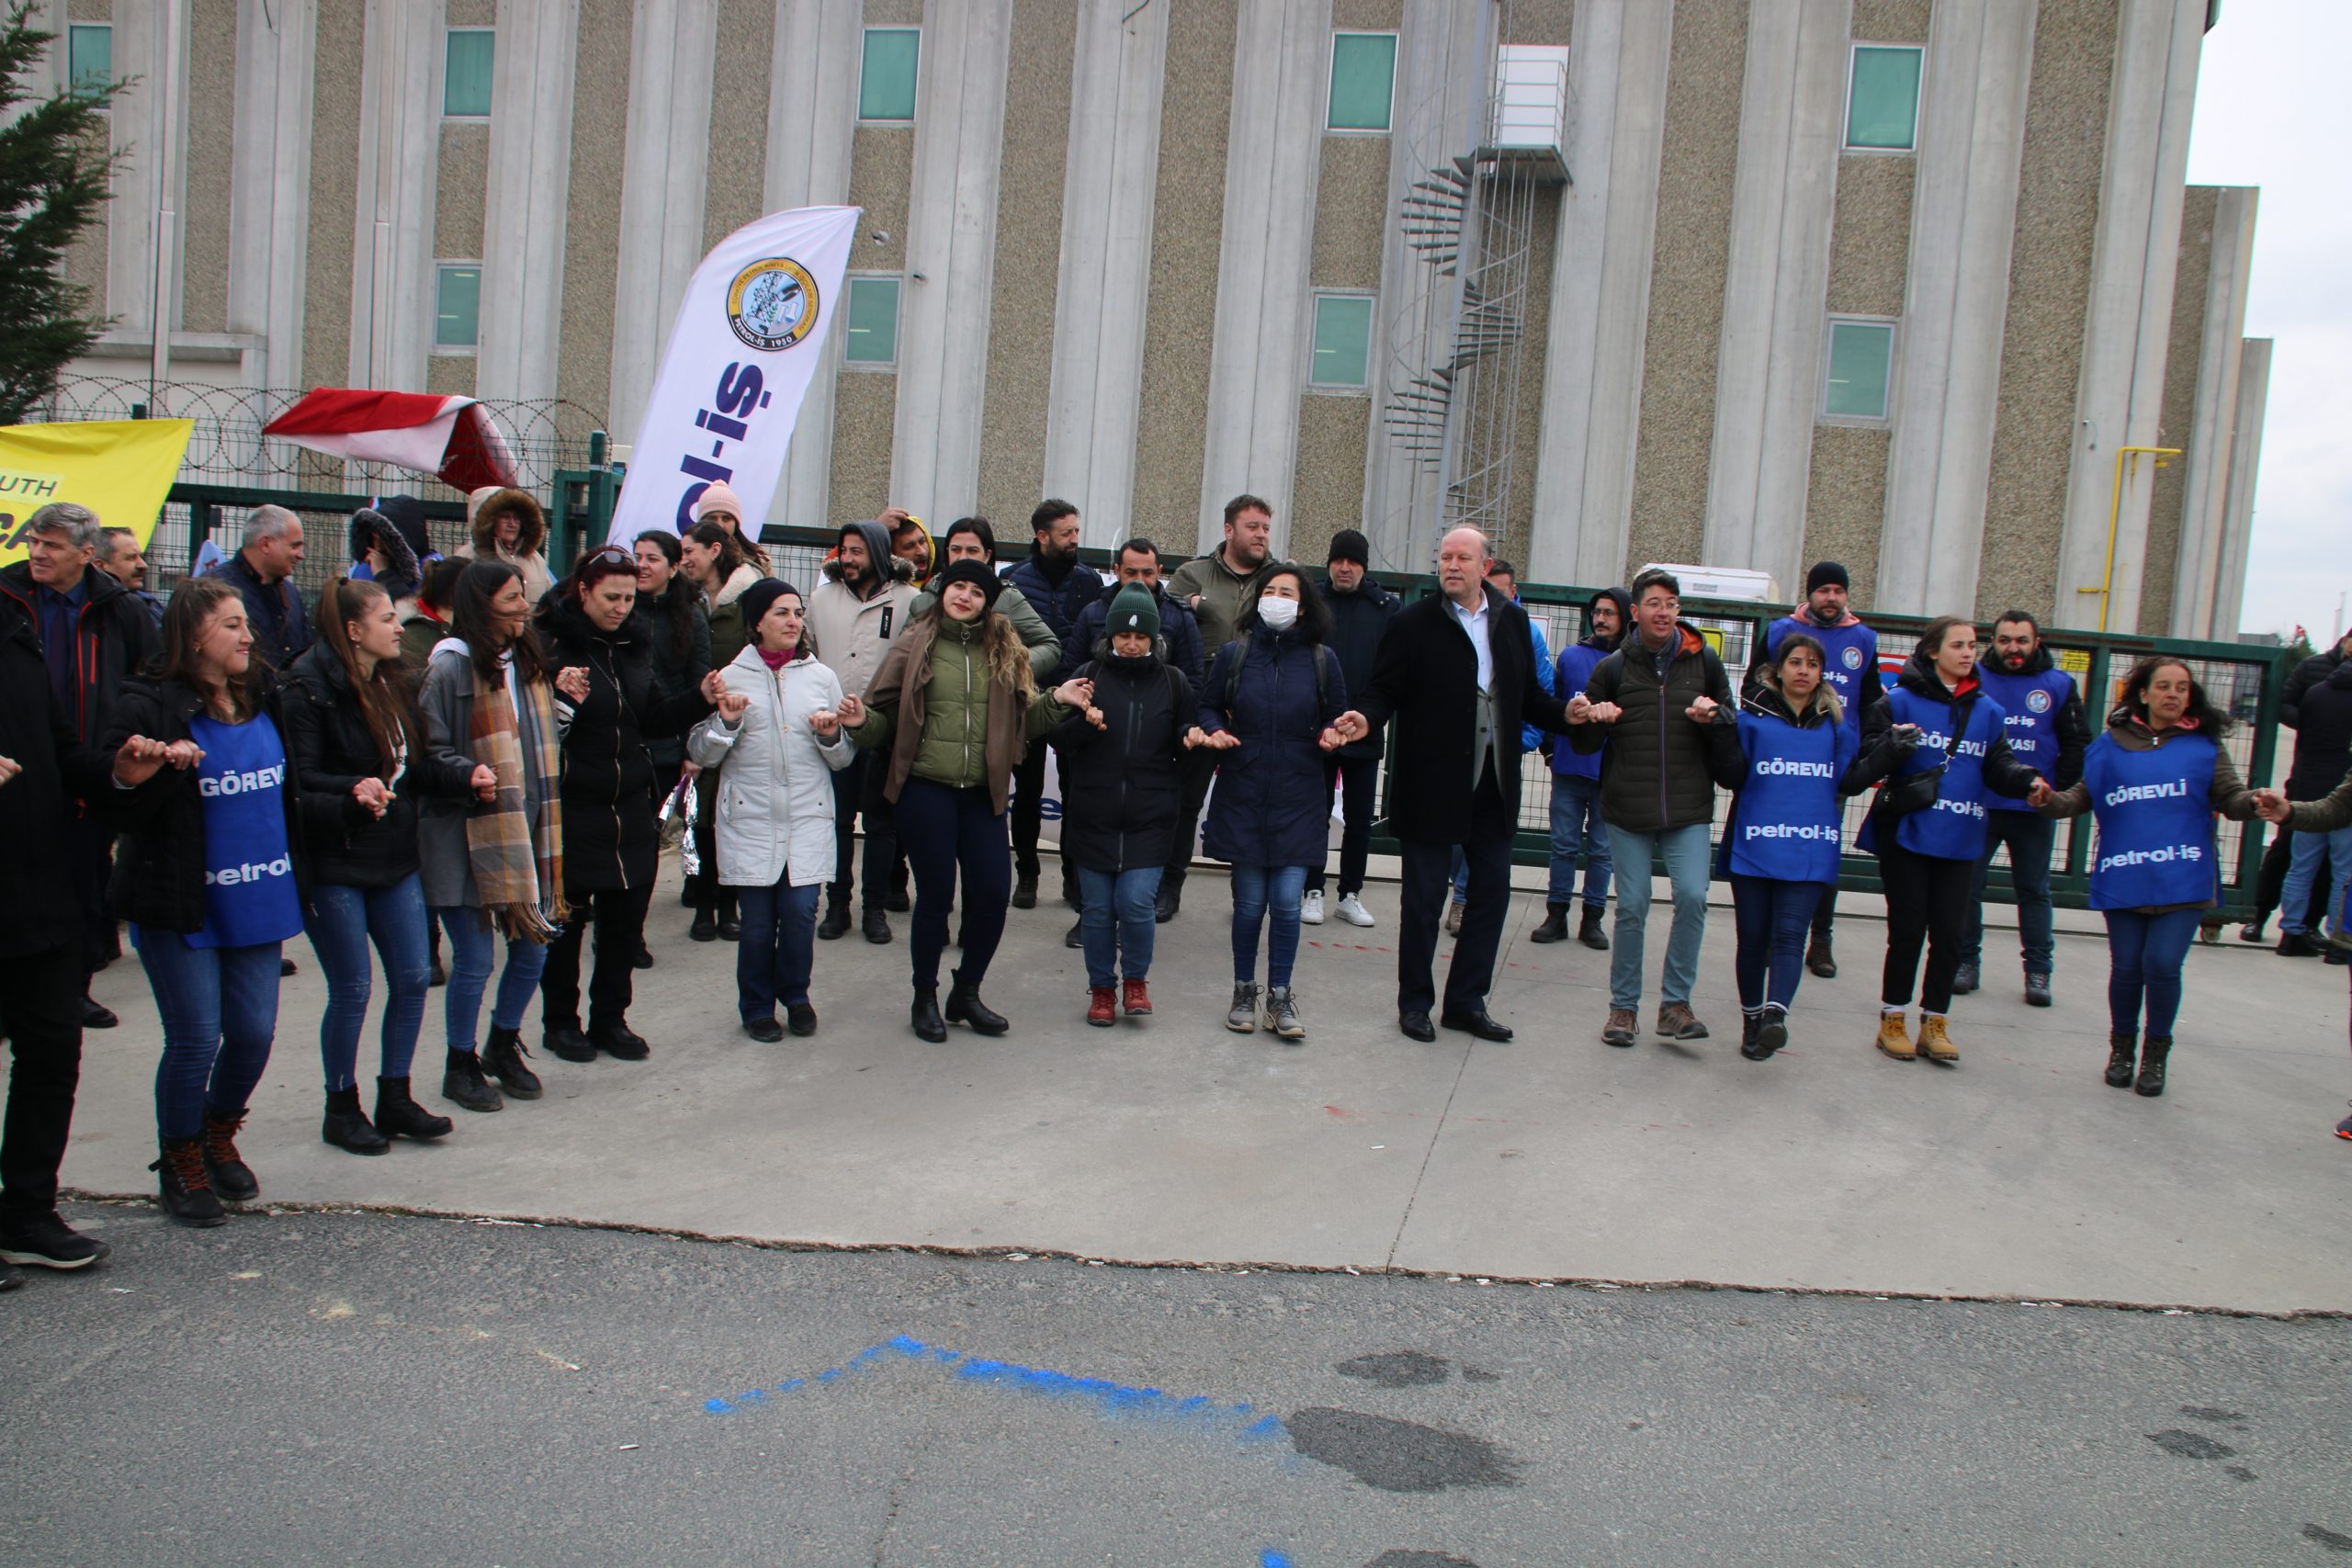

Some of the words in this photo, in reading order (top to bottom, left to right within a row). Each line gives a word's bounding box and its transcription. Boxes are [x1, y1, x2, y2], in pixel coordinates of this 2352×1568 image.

[771, 336, 793, 348] 1950
[1756, 757, 1834, 779] GÖREVLİ
[2105, 778, 2187, 807] GÖREVLİ
[1746, 823, 1839, 844] petrol-iş
[2099, 844, 2202, 873] petrol-iş
